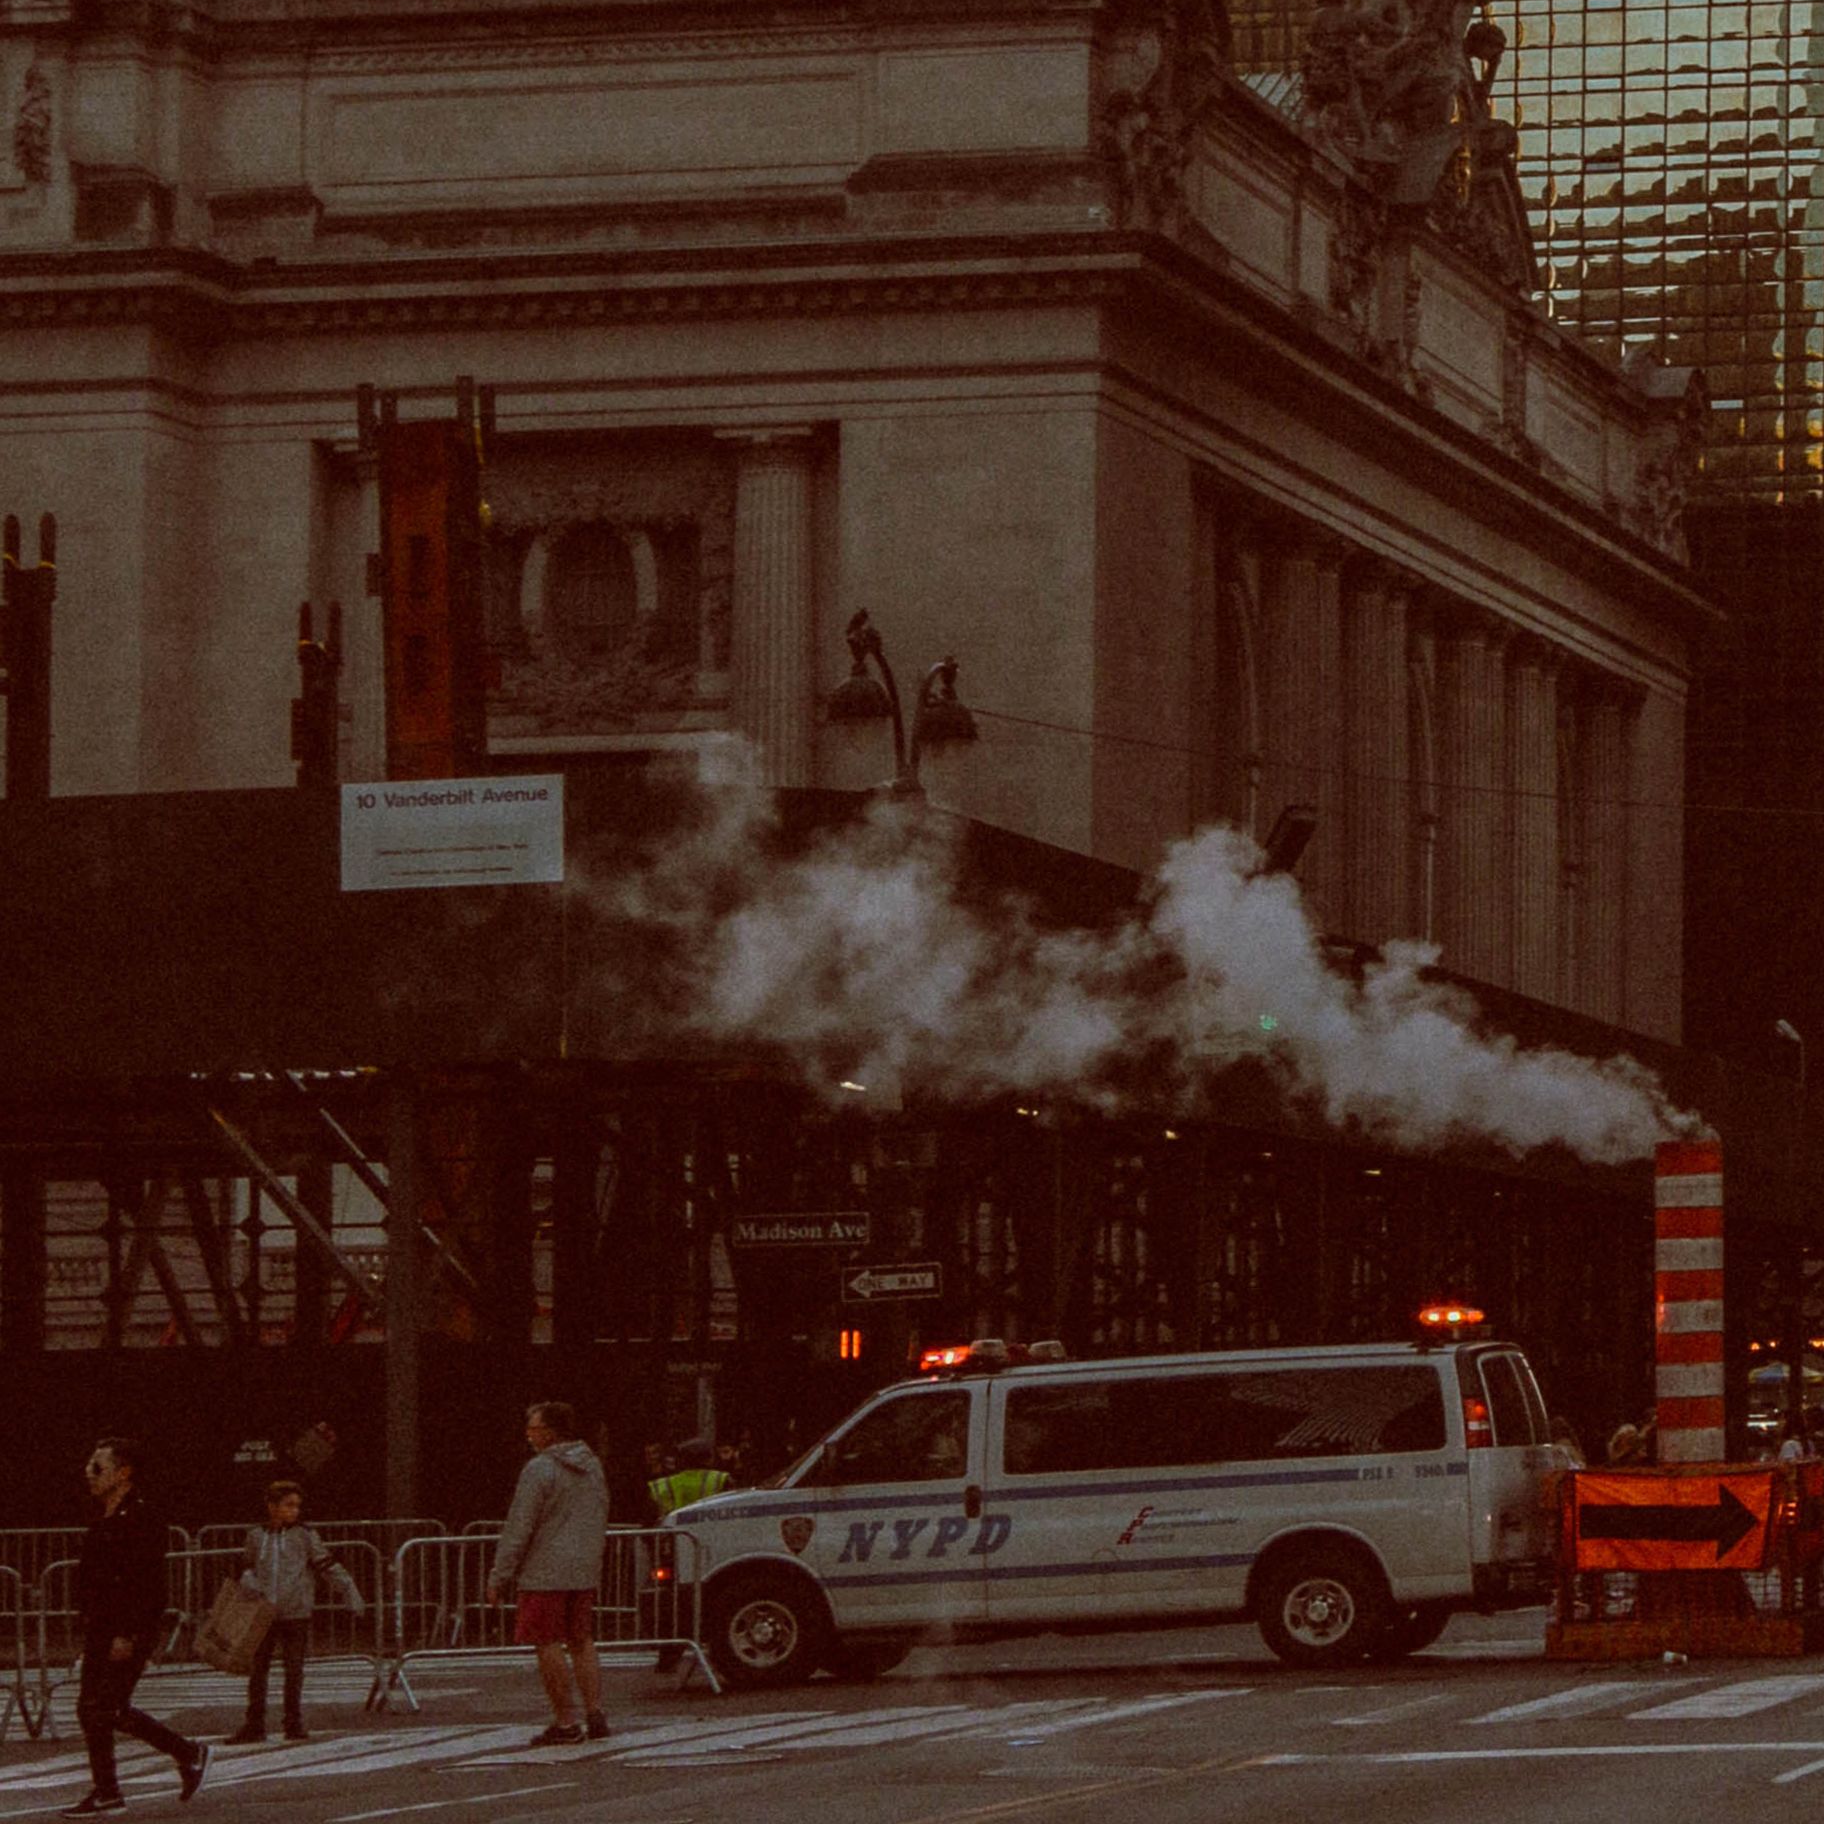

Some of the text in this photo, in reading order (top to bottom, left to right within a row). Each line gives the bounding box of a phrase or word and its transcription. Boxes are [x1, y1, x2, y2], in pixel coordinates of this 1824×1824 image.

[357, 788, 548, 809] 10 Vanderbilt Avenue
[737, 1221, 867, 1241] Madison Ave
[858, 1274, 929, 1290] ONE WAY
[700, 1507, 750, 1522] POLICE
[838, 1515, 1012, 1563] NYPD
